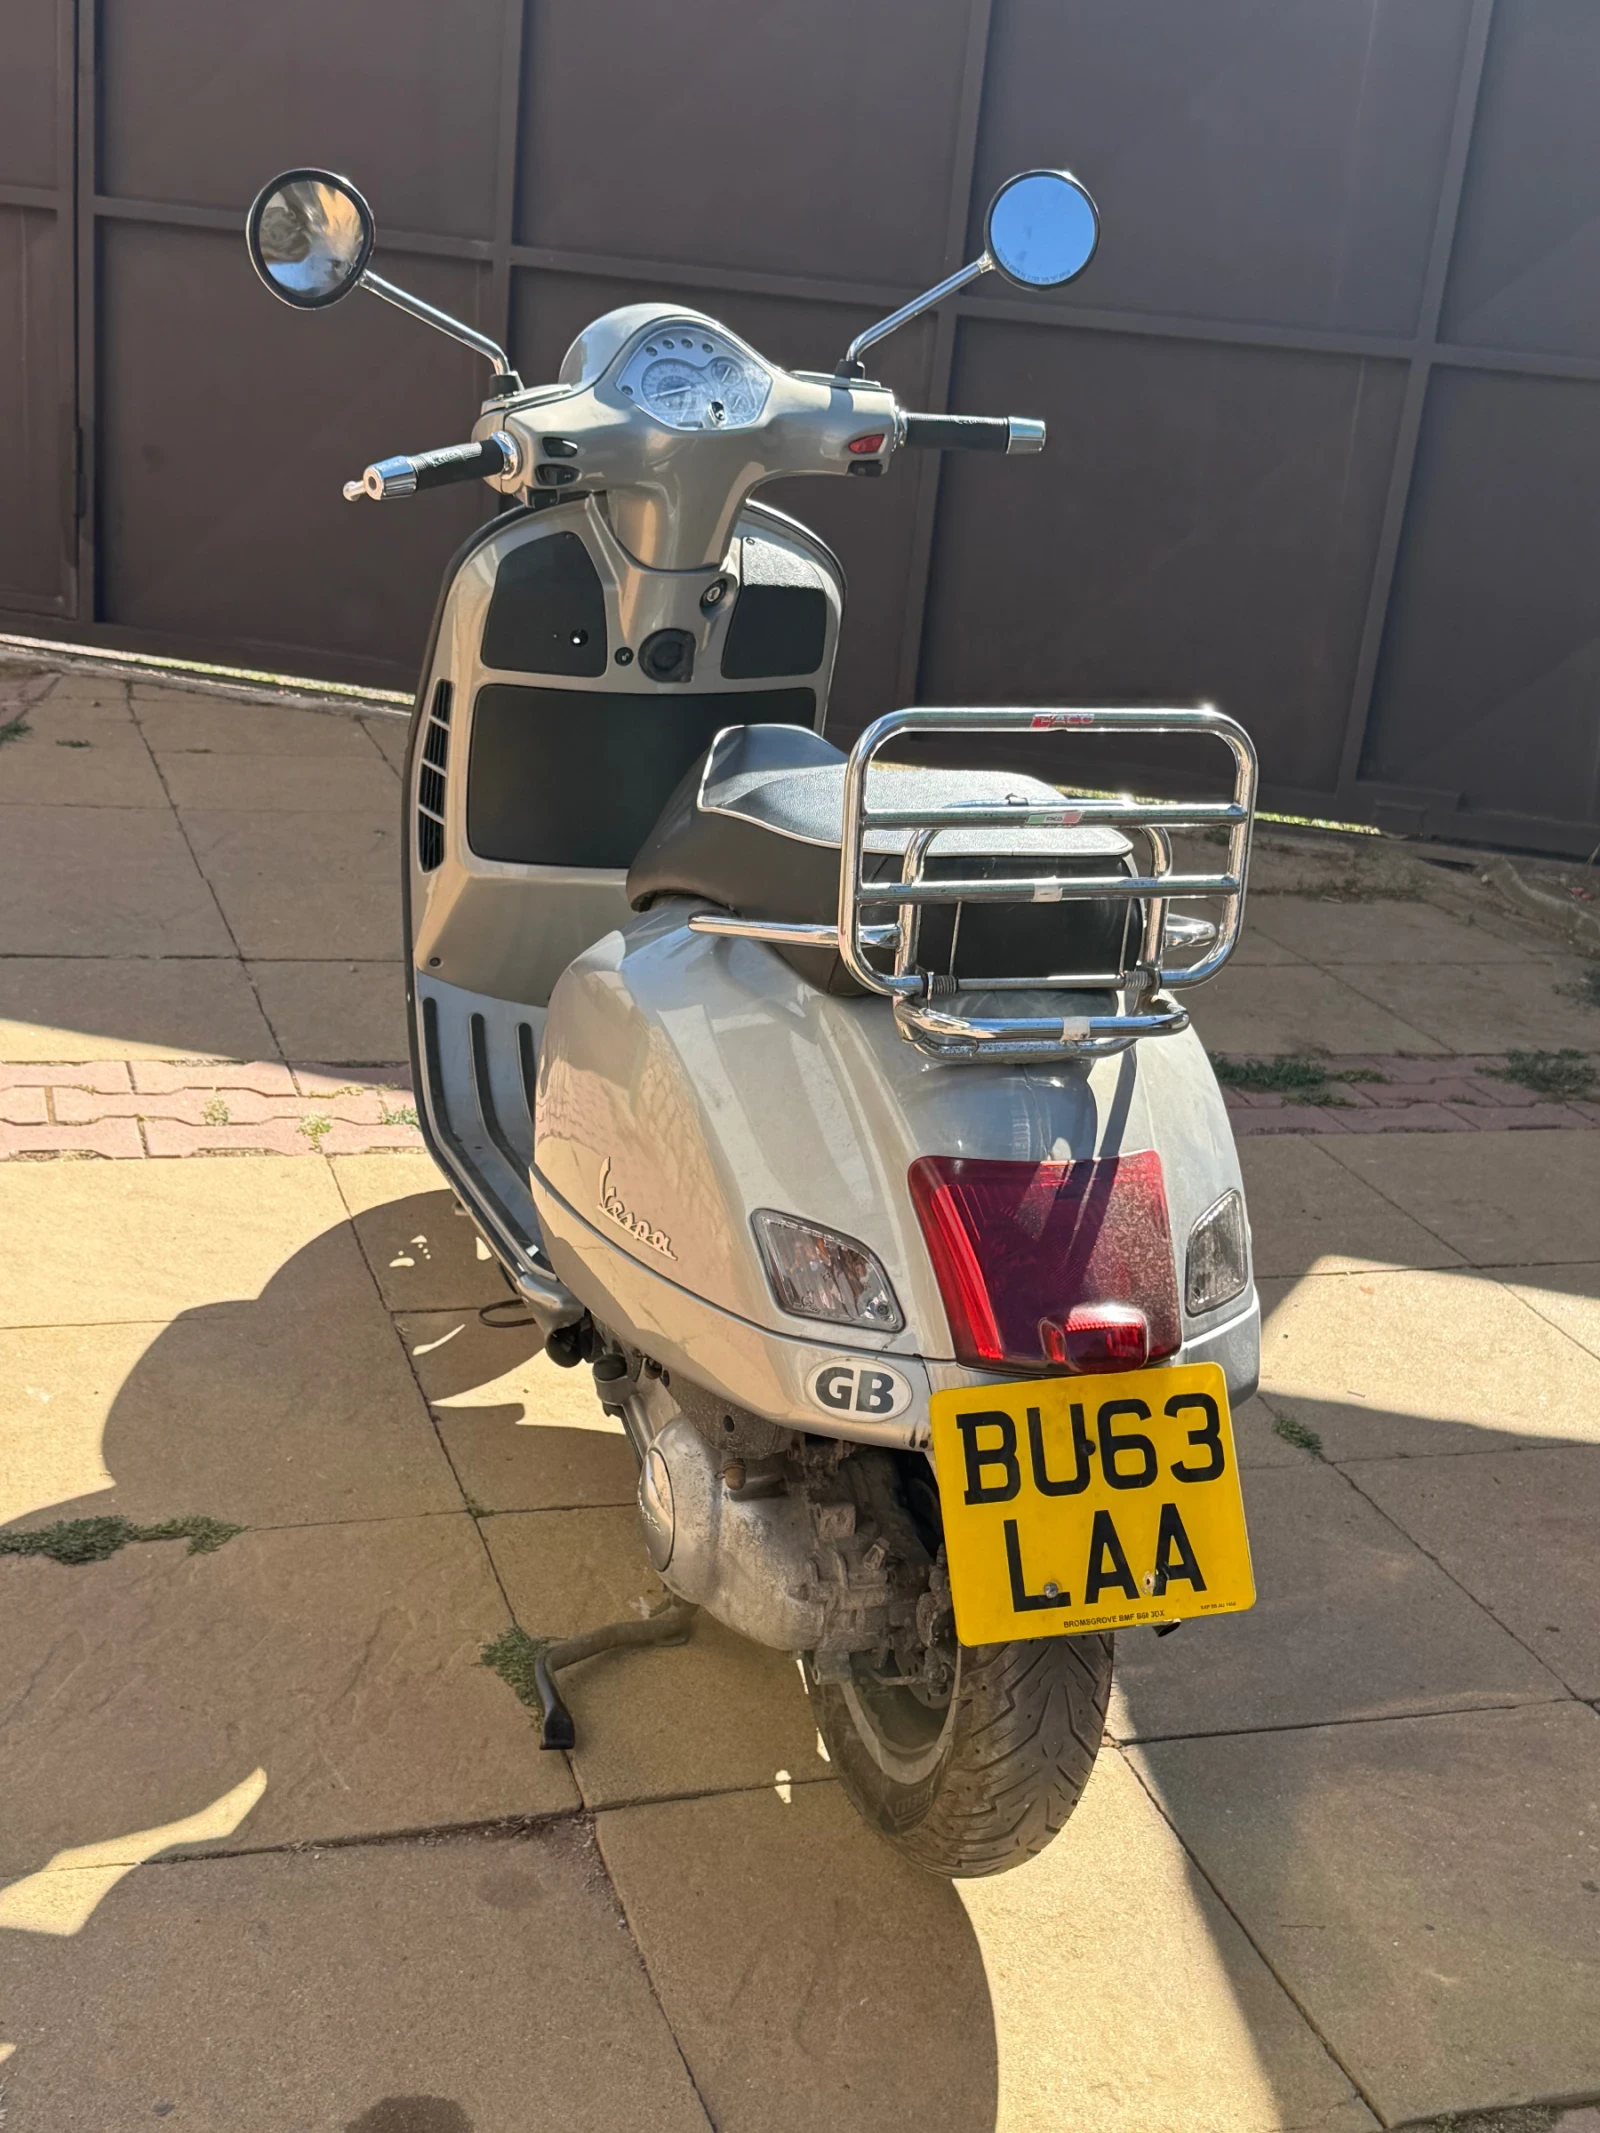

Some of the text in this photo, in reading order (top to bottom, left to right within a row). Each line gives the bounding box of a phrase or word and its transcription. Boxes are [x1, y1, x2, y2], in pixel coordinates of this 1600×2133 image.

[597, 1156, 678, 1261] Vespa
[815, 1366, 895, 1414] GB
[956, 1393, 1225, 1505] BU63
[1003, 1503, 1207, 1612] LAA
[1063, 1615, 1117, 1628] BROMSGROVE
